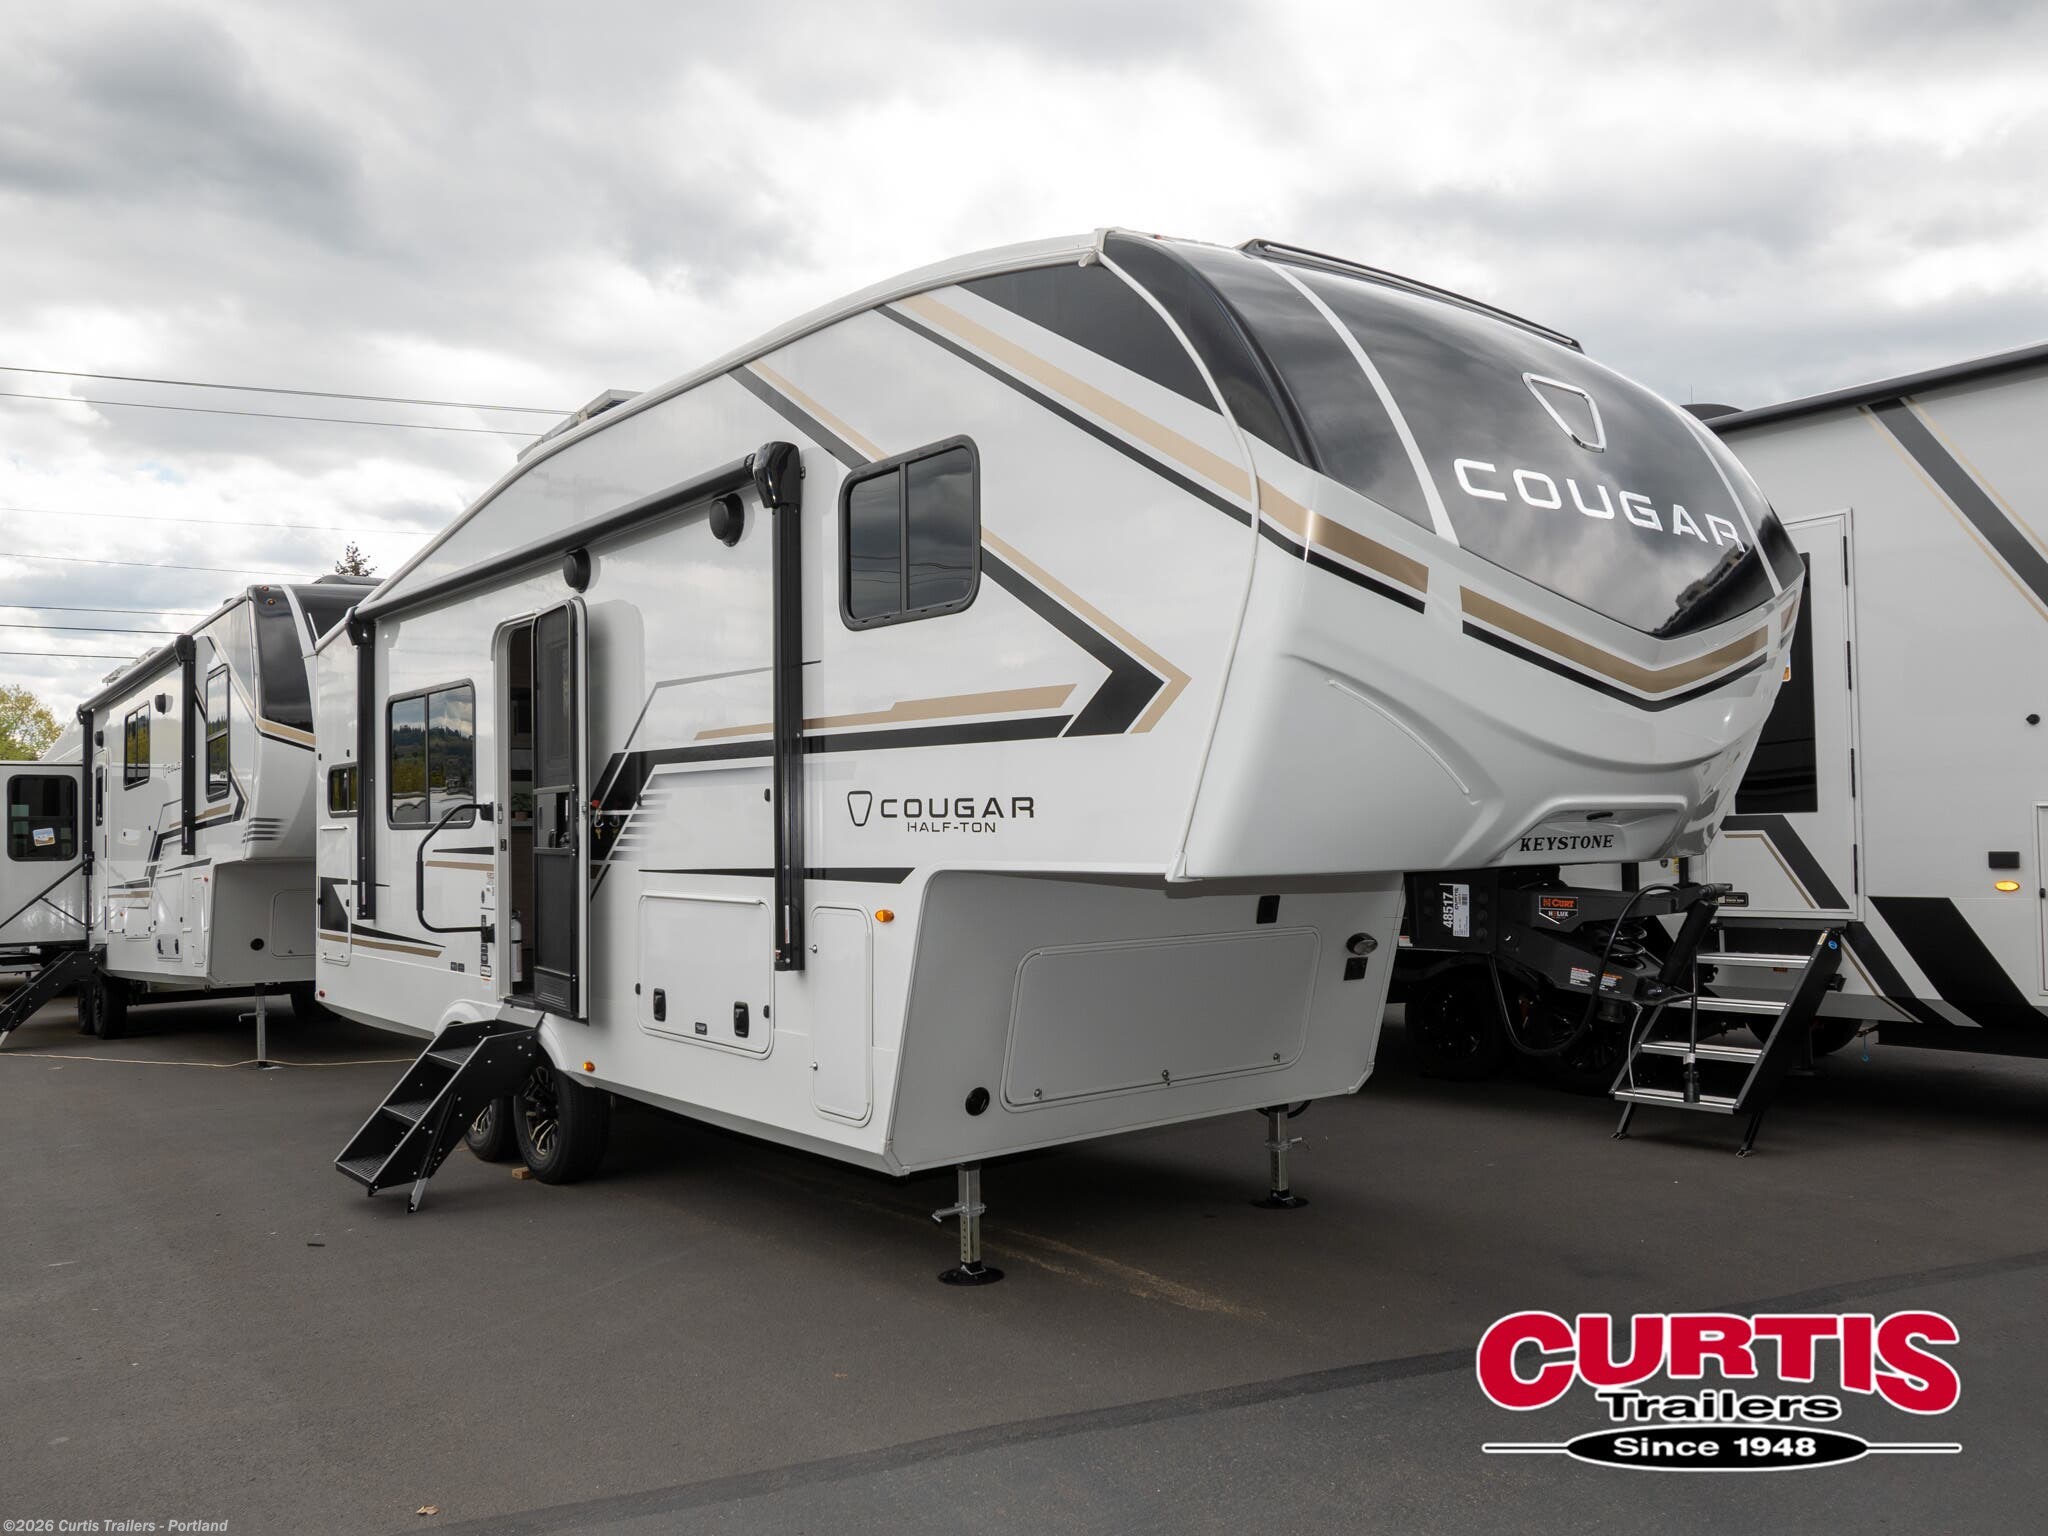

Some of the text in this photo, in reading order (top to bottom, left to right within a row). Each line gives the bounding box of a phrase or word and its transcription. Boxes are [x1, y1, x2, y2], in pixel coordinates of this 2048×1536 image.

[1453, 457, 1746, 553] COUGAR
[880, 796, 1035, 819] COUGAR
[907, 822, 996, 833] HALF-TON
[1519, 834, 1614, 852] KEYSTONE
[1442, 891, 1454, 928] 48517
